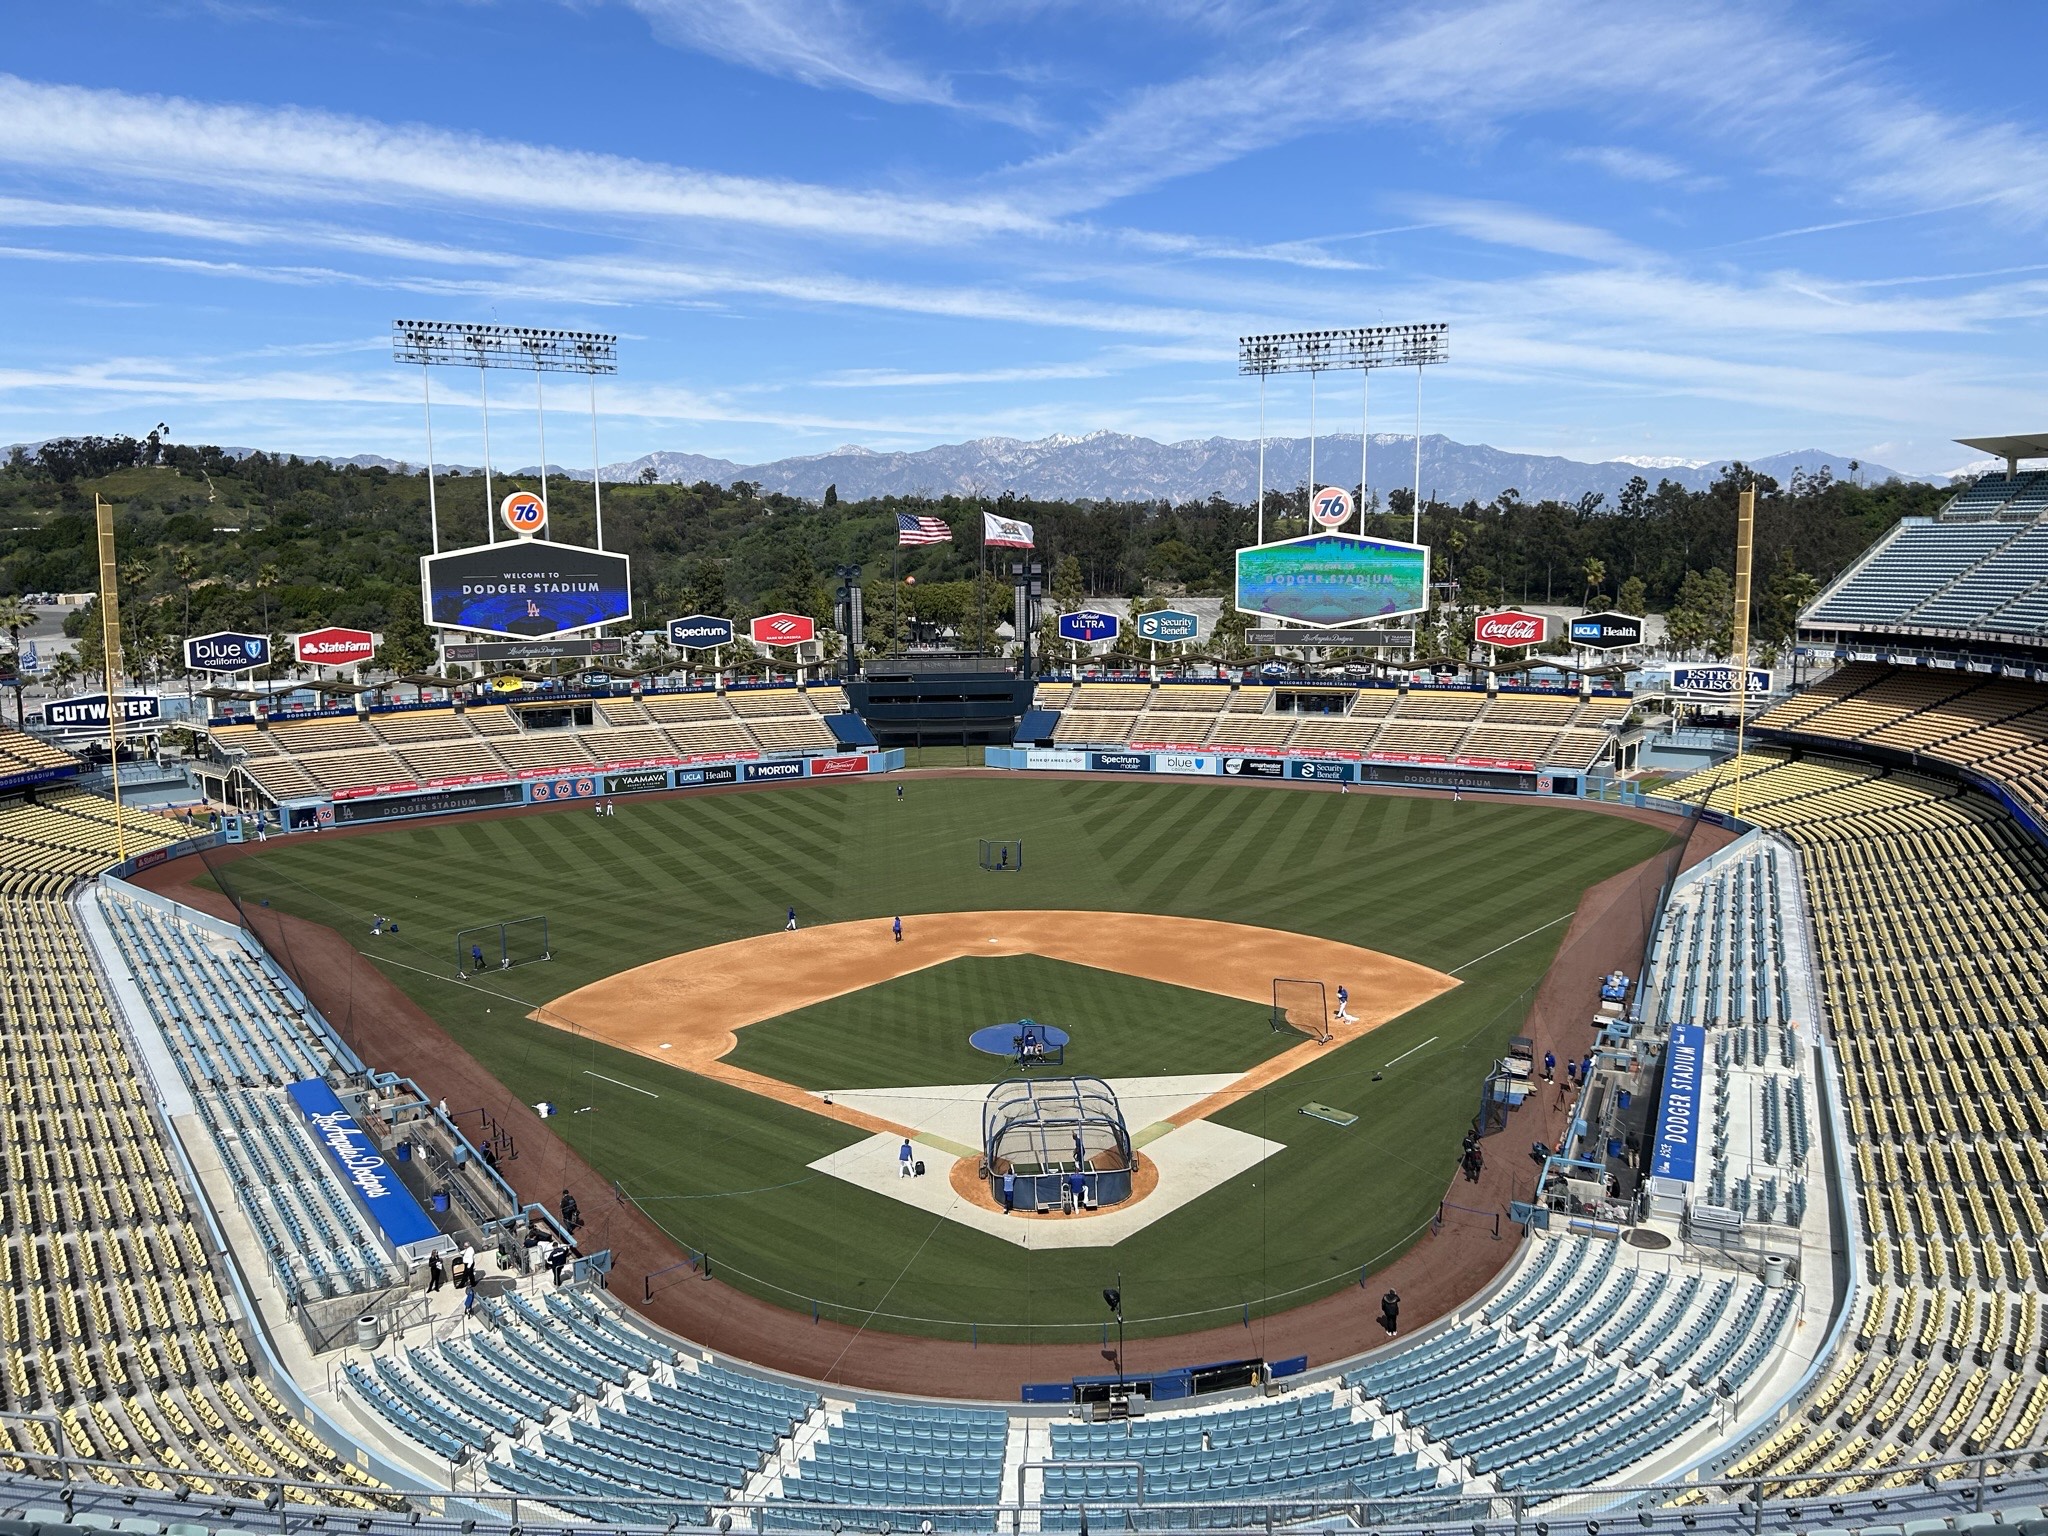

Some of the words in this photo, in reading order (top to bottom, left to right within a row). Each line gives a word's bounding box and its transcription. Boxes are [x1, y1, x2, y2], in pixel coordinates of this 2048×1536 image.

[1318, 496, 1345, 517] 76
[513, 503, 539, 523] 76
[1265, 575, 1323, 584] DODGER
[1330, 574, 1394, 584] STADIUM
[462, 584, 527, 595] DODGER
[534, 582, 600, 594] STADIUM
[526, 599, 540, 617] LA
[1072, 620, 1105, 629] ULTRA
[1161, 617, 1193, 628] Security
[674, 626, 724, 639] Spectrum
[1161, 626, 1189, 635] Benefit
[1481, 619, 1538, 639] Coca-Cola
[1574, 626, 1598, 635] UCLA
[1603, 626, 1637, 637] Health
[1859, 623, 1923, 636] DODGER
[1934, 628, 2001, 642] STADIUM
[2012, 635, 2044, 646] CLUB
[196, 641, 241, 658] blue
[204, 657, 247, 666] california
[1680, 679, 1743, 690] JALISCO
[52, 701, 153, 722] CUTWATER
[286, 711, 311, 719] DODGER
[313, 709, 341, 717] STADIUM
[1101, 755, 1137, 765] Spectrum
[1167, 757, 1192, 768] blue
[78, 763, 92, 773] 2:12
[758, 765, 799, 776] MORTON
[1316, 763, 1344, 773] Security
[26, 771, 55, 781] STADIUM
[682, 773, 701, 781] UCLA
[705, 770, 732, 780] Health
[1316, 771, 1340, 779] Benefit
[1404, 775, 1444, 785] DODGER
[1447, 777, 1491, 787] STADIUM
[1539, 780, 1551, 789] 76
[535, 788, 547, 796] 76
[557, 785, 569, 793] 76
[579, 782, 591, 791] 76
[384, 804, 427, 815] DODGER
[431, 798, 477, 810] STADIUM
[319, 810, 331, 819] 76
[1671, 1046, 1695, 1090] STADIUM
[312, 1111, 351, 1130] Los
[1664, 1094, 1691, 1144] DODGER
[326, 1126, 365, 1164] Angeles
[348, 1156, 391, 1198] Dodgers
